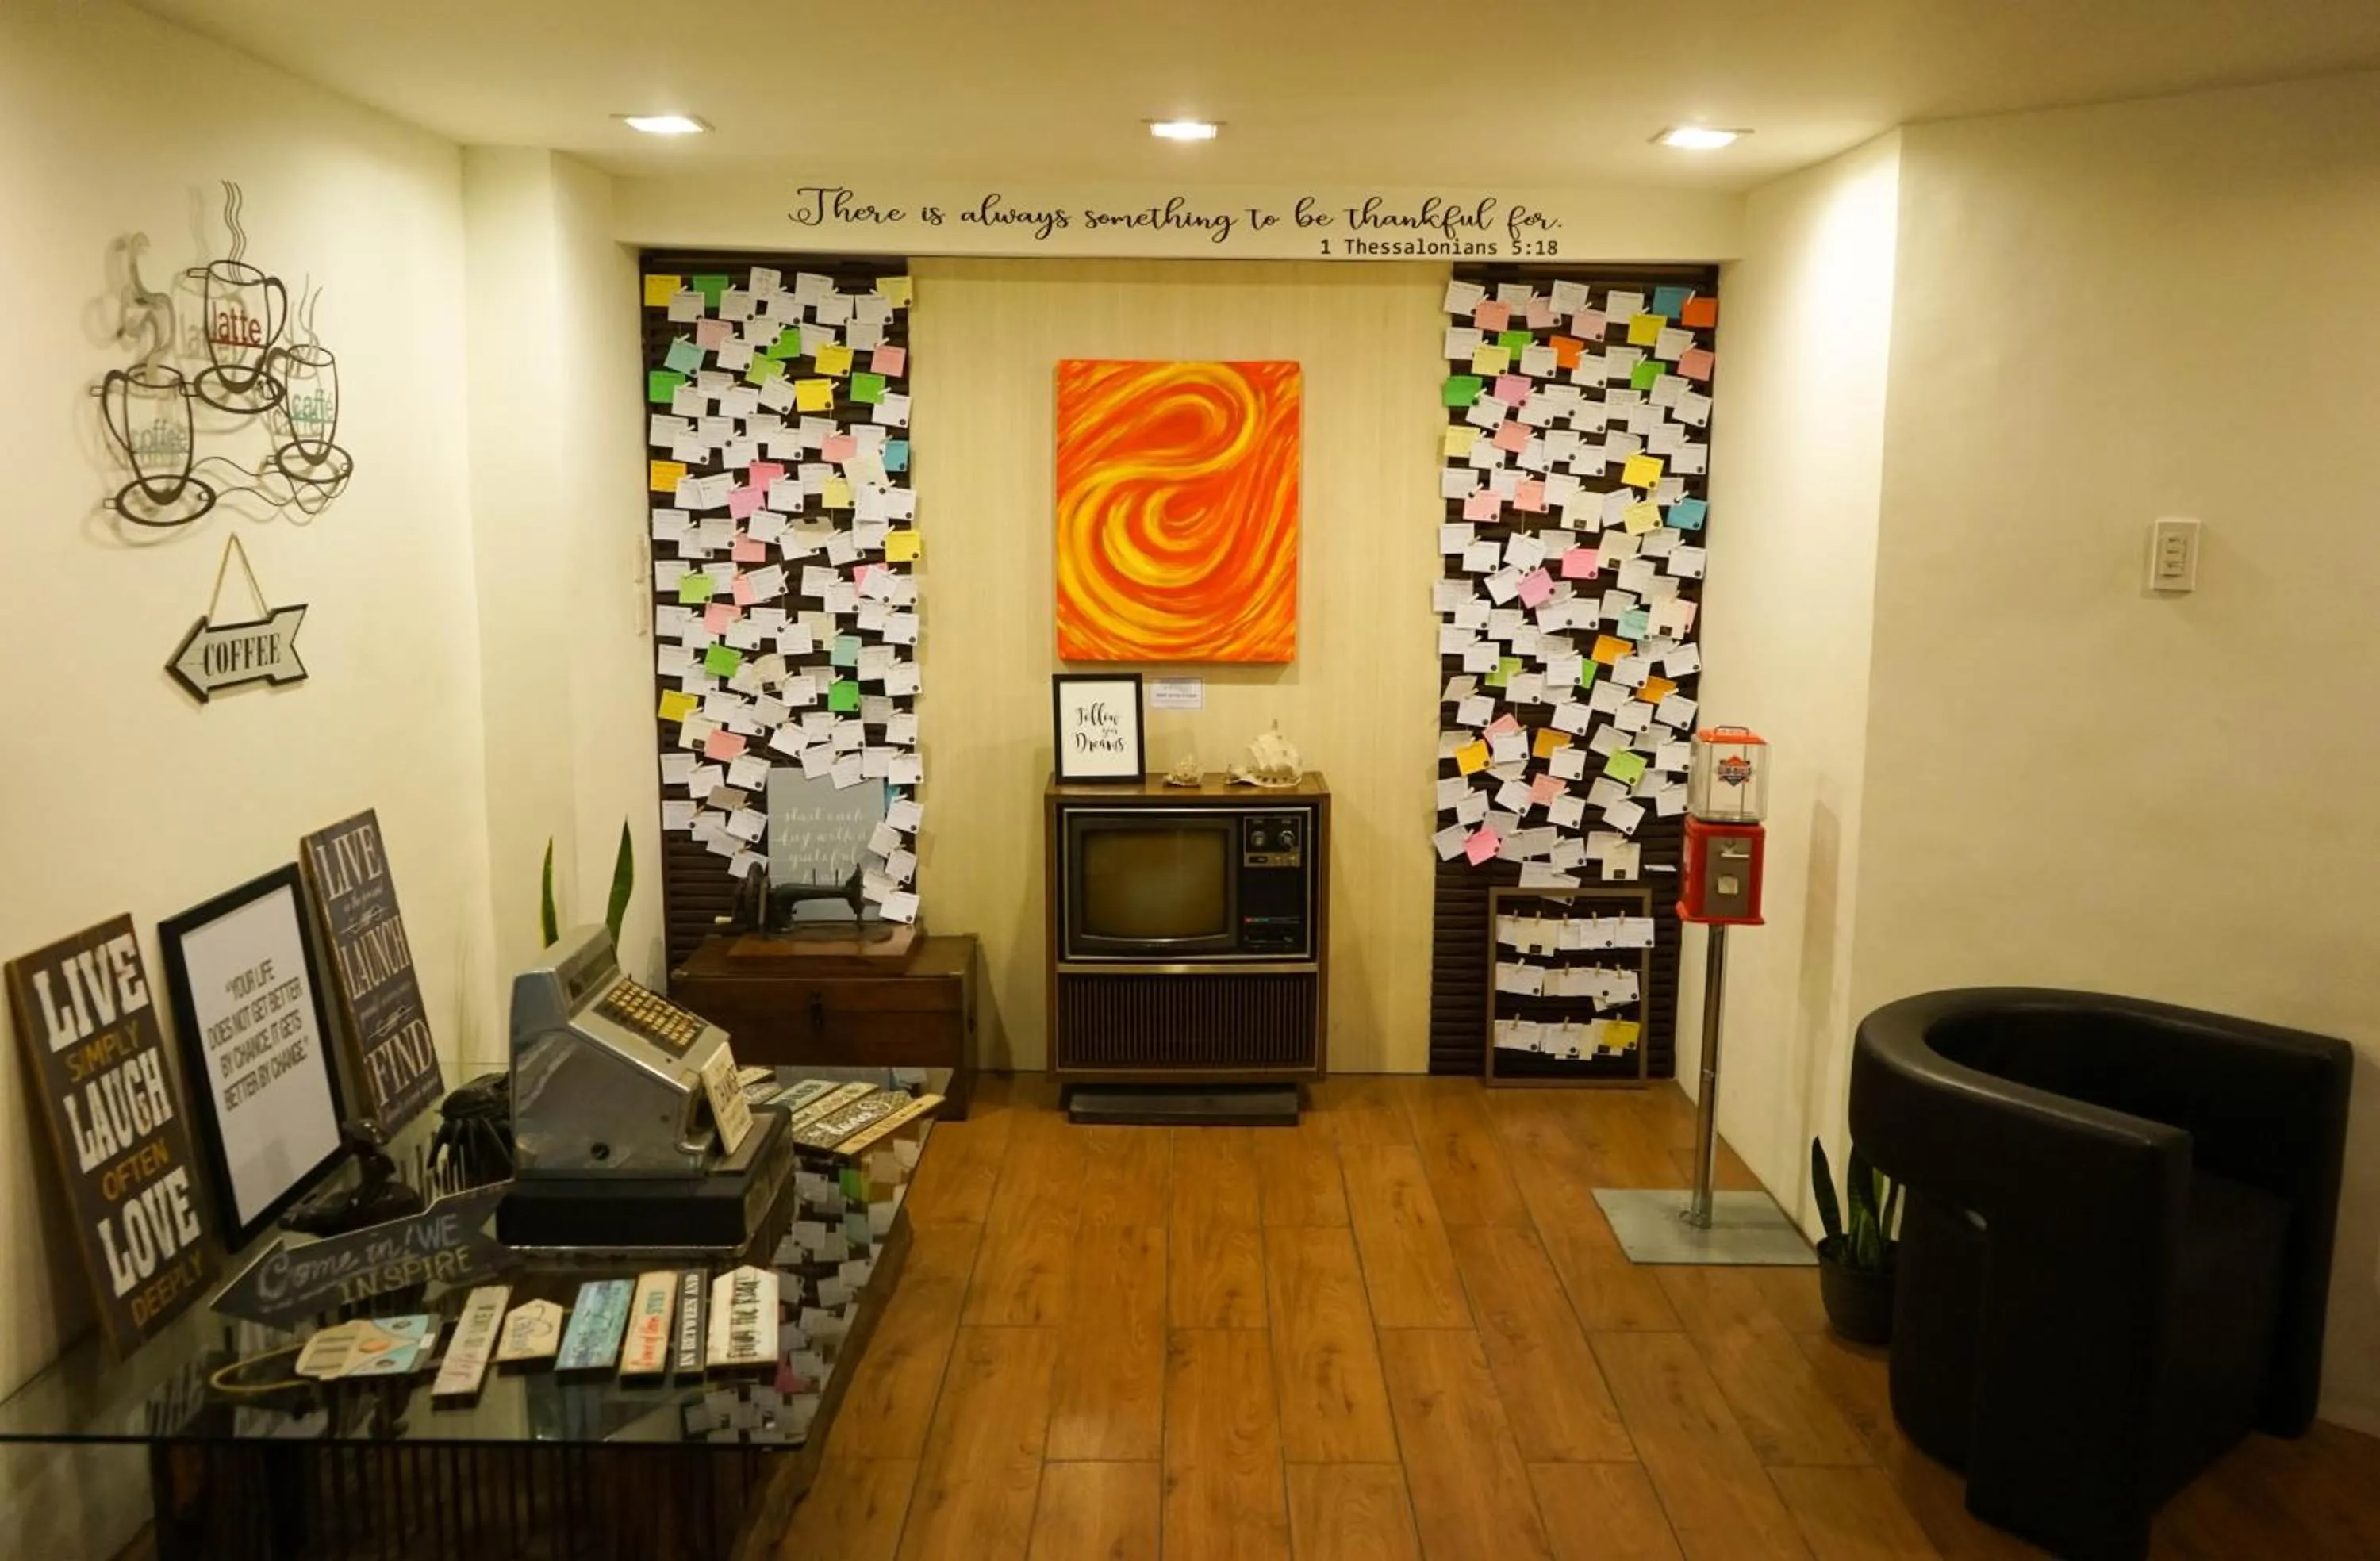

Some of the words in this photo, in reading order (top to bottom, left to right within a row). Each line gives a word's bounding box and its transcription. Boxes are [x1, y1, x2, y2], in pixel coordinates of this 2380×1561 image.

[789, 187, 906, 225] There
[921, 204, 946, 226] is
[961, 194, 1072, 240] always
[1084, 197, 1237, 243] something
[1246, 208, 1280, 228] to
[1294, 197, 1334, 228] be
[1344, 197, 1497, 240] thankful
[1507, 206, 1563, 240] for.
[1320, 240, 1332, 255] 1
[1345, 239, 1498, 255] Thessalonians
[1511, 240, 1559, 255] 5:18
[211, 301, 262, 346] latte
[204, 633, 280, 677] COFFEE
[316, 824, 383, 901] LIVE
[340, 914, 411, 1001] LAUNCH
[33, 933, 149, 1053] LIVE
[267, 976, 304, 1013] BETTER
[65, 1020, 140, 1082] SIMPLY
[368, 1019, 433, 1107] FIND
[63, 1047, 174, 1173] LAUGH
[223, 1070, 260, 1112] BETTER
[102, 1137, 170, 1200] OFTEN
[97, 1164, 201, 1298] LOVE
[258, 1250, 359, 1298] Come
[415, 1213, 461, 1250] WE
[131, 1250, 203, 1329] DEEPLY
[339, 1244, 474, 1305] INSPIRE
[685, 1273, 700, 1296] AND
[680, 1298, 699, 1351] BETWEEN
[679, 1352, 696, 1367] IN
